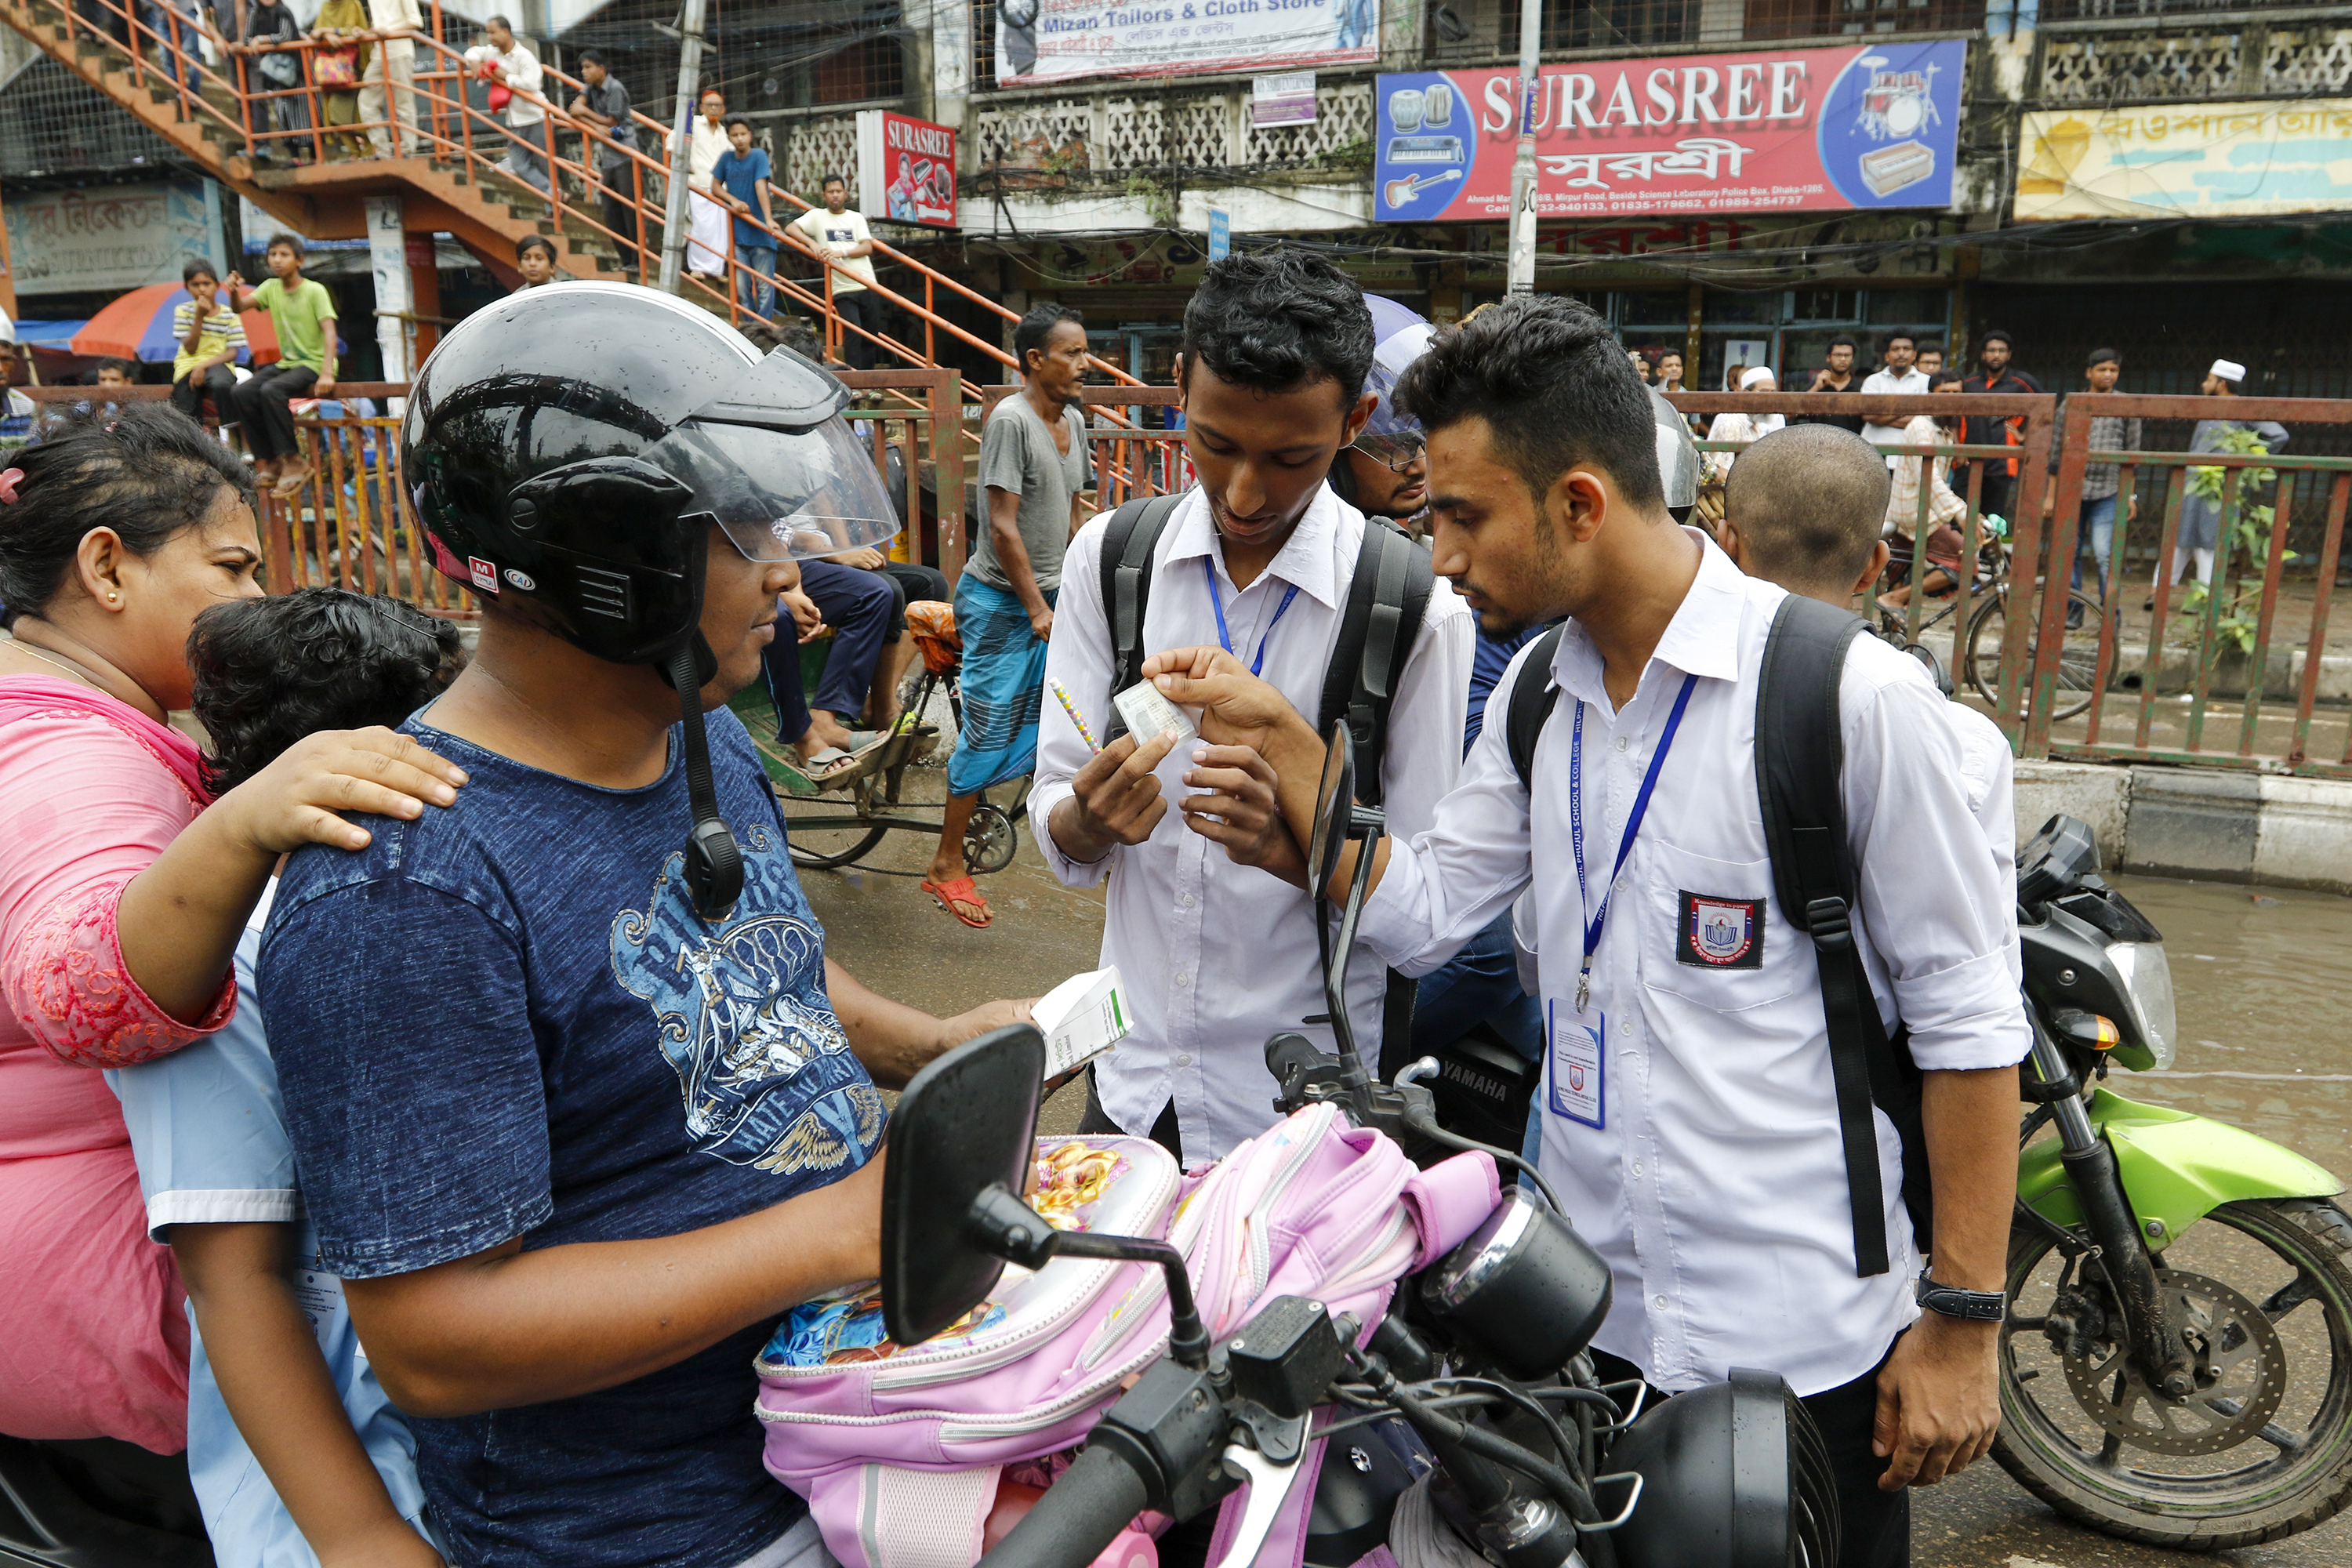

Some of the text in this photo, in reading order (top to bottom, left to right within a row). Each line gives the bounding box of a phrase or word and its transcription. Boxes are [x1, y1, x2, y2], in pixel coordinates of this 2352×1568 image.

[1044, 16, 1098, 32] Mizan
[1105, 8, 1174, 27] Tailors
[1182, 2, 1196, 19] &
[1206, 0, 1258, 16] Cloth
[1267, 0, 1325, 10] Store
[1125, 26, 1163, 43] লেডিস
[1483, 60, 1806, 132] SURASREE
[887, 119, 951, 158] SURASREE
[1555, 193, 1582, 202] Mirpur
[1584, 192, 1608, 201] Road,
[1609, 191, 1642, 200] Beside
[1642, 190, 1672, 199] Science
[1674, 189, 1719, 198] Laboratory
[1722, 187, 1748, 196] Police
[1750, 187, 1769, 195] Box,
[1708, 195, 1803, 207] 01989-254737
[475, 562, 488, 574] M
[1694, 898, 1726, 907] Knowledge
[1064, 1034, 1073, 1055] Limited
[1443, 1060, 1507, 1102] YAMAHA
[731, 1091, 795, 1152] HATE
